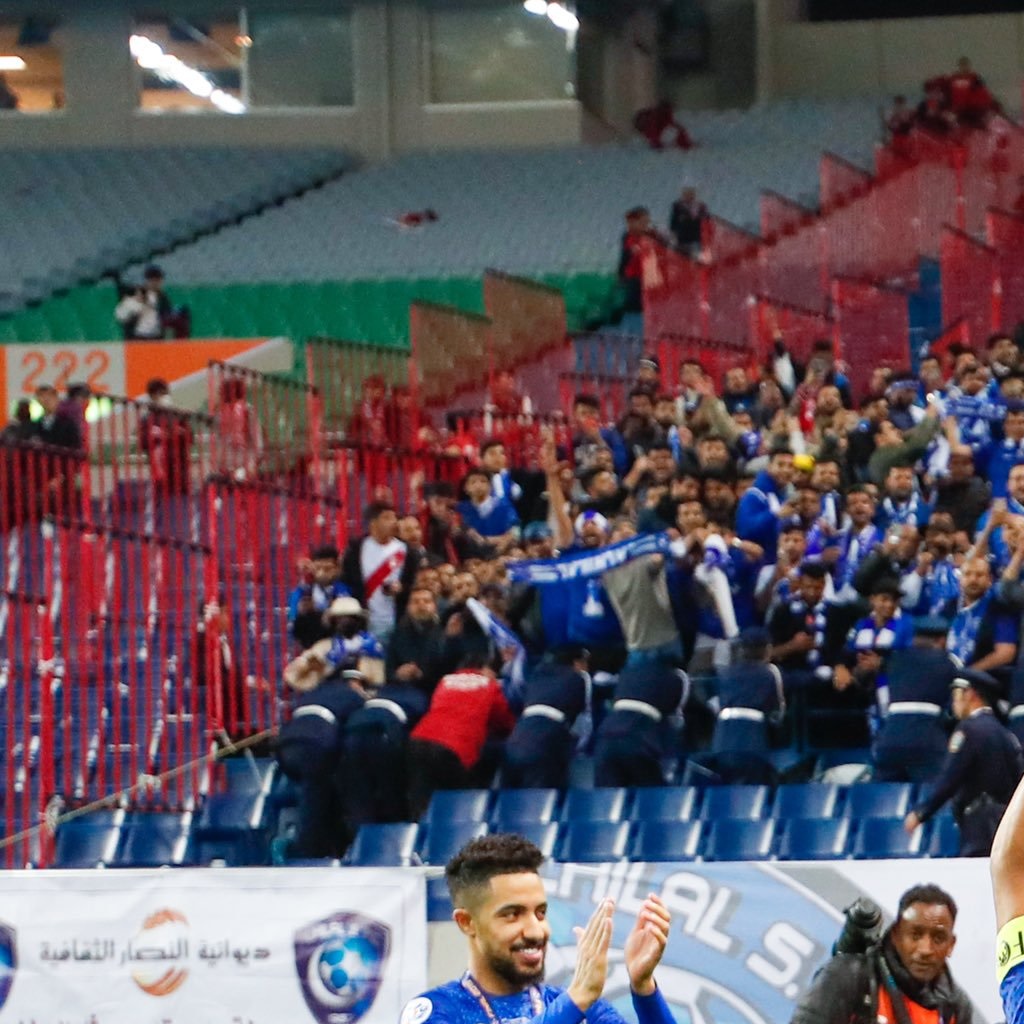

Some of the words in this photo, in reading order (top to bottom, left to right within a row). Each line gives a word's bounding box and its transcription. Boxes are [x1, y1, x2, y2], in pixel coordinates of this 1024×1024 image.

[21, 349, 110, 394] 222
[40, 938, 115, 965] الثقافية
[198, 940, 271, 967] ديوانية
